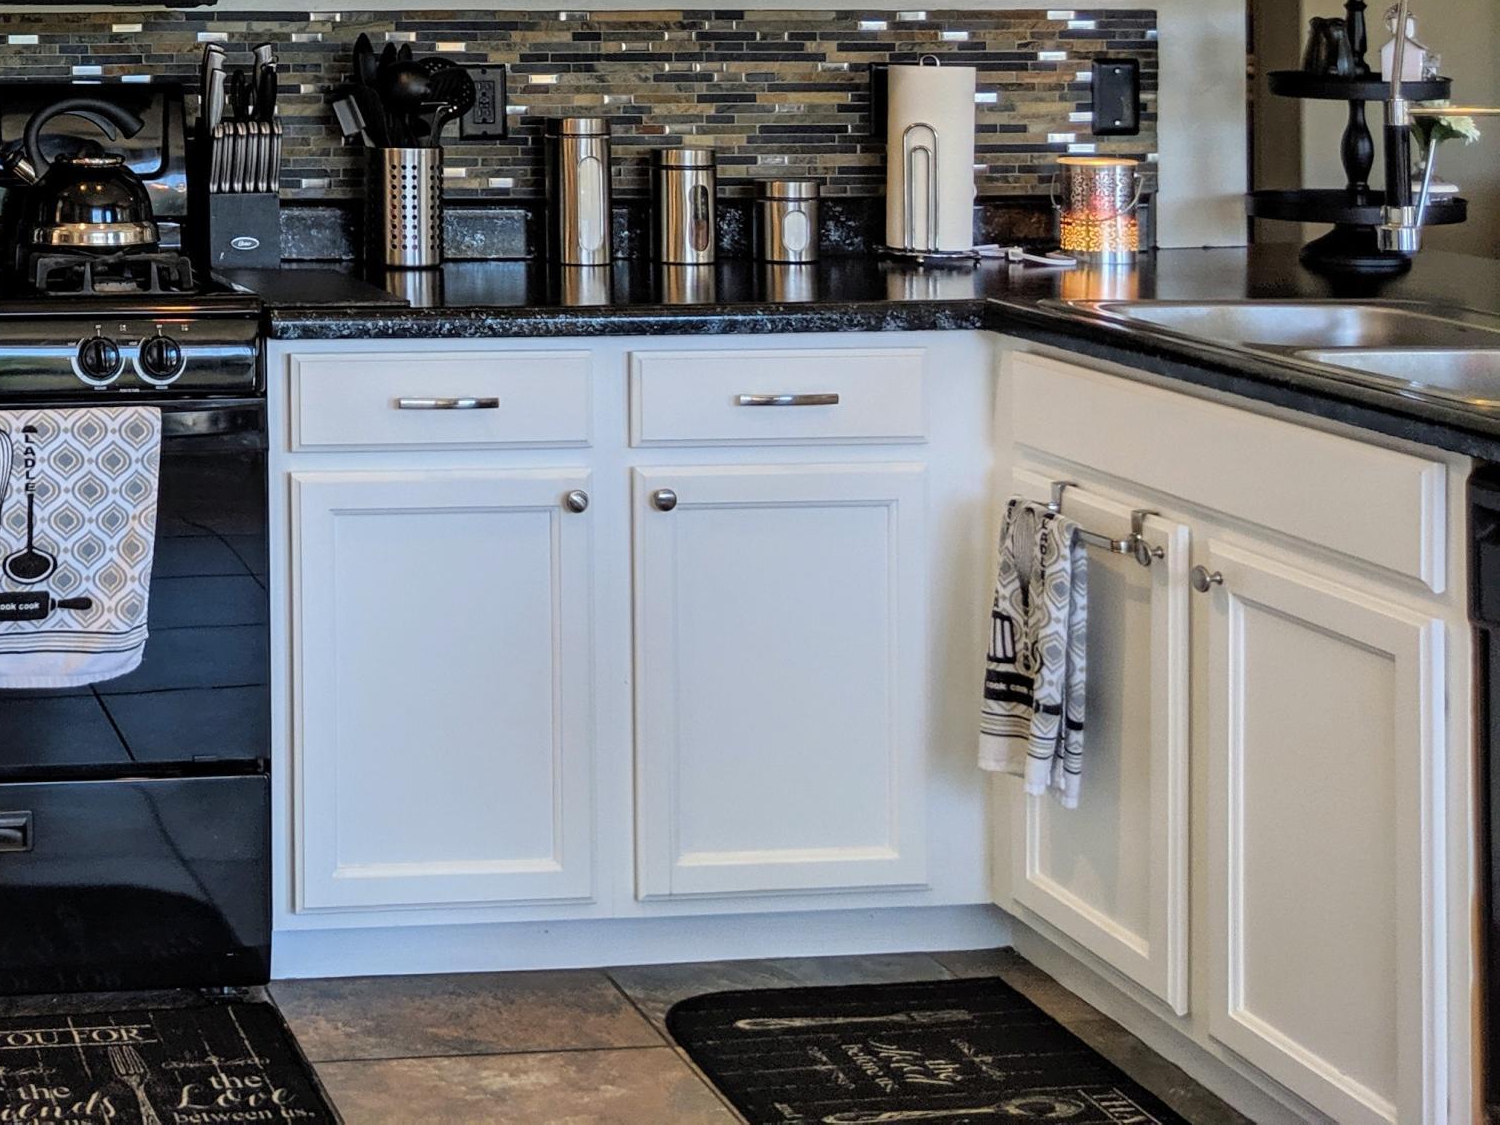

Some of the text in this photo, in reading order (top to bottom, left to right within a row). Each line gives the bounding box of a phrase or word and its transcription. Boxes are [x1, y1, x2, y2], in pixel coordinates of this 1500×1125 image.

[24, 435, 36, 492] LADLE
[18, 600, 41, 611] cook
[72, 1028, 145, 1044] FOR
[209, 1073, 262, 1089] the
[18, 1083, 72, 1100] the
[173, 1109, 273, 1124] between
